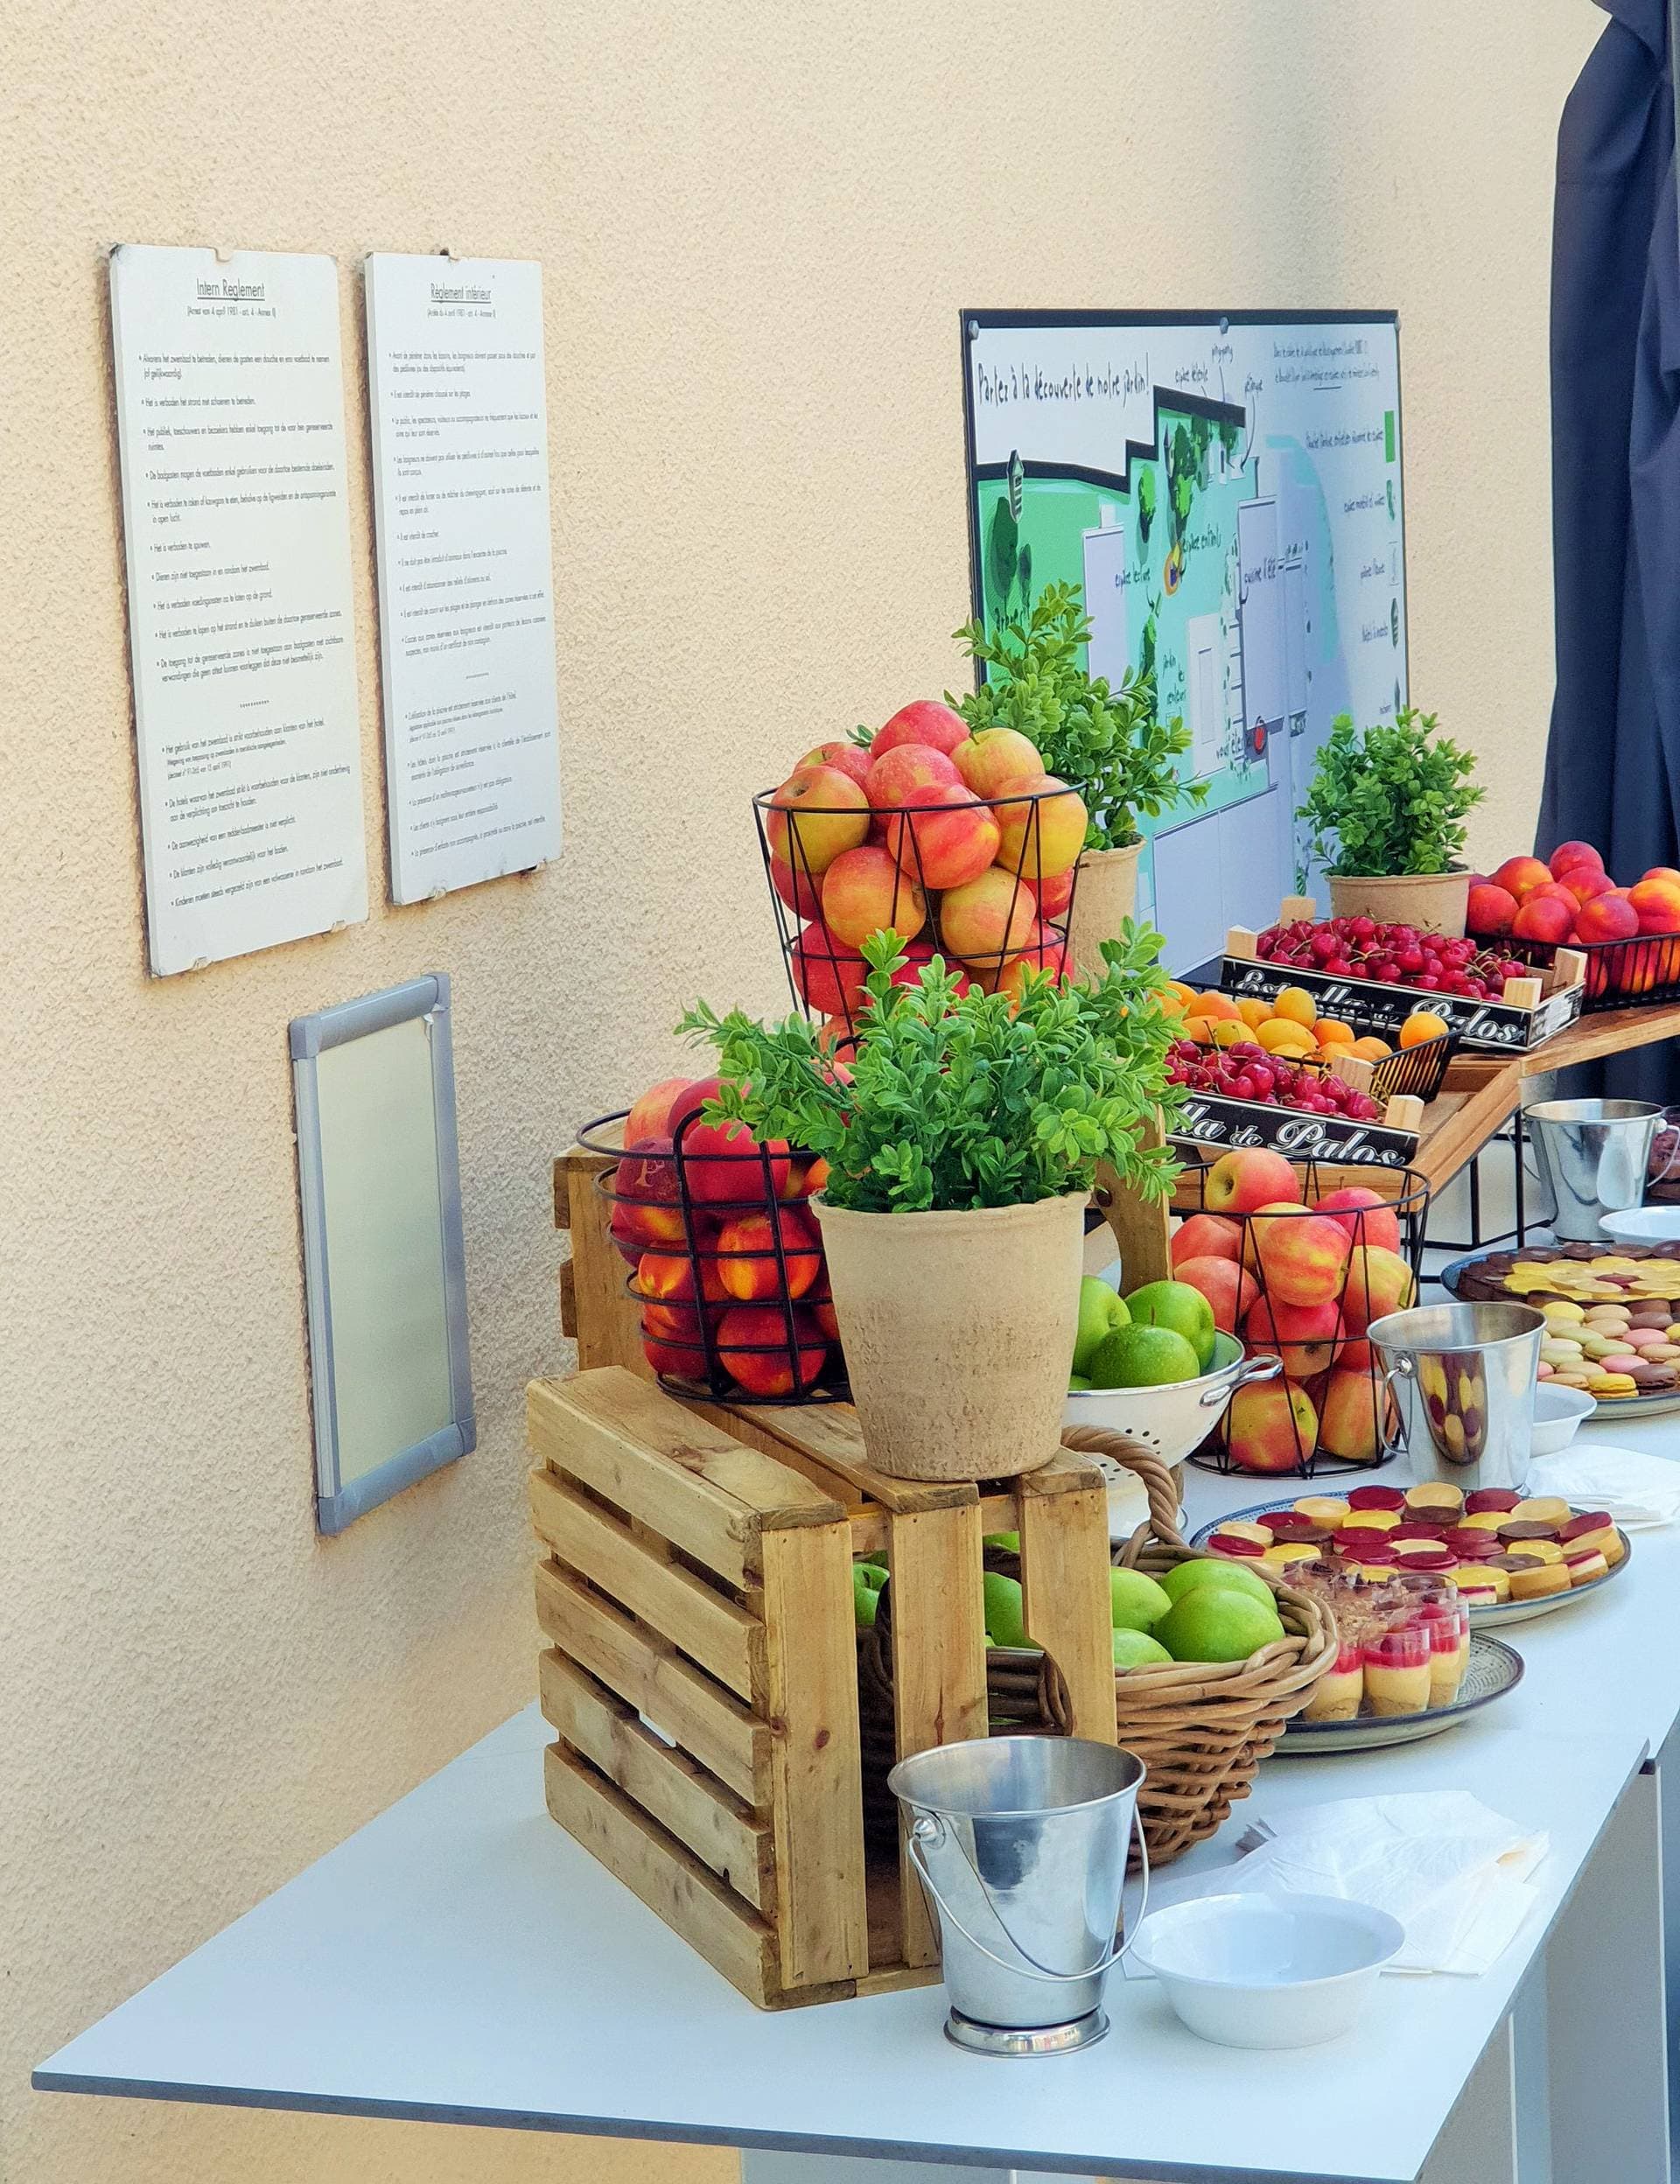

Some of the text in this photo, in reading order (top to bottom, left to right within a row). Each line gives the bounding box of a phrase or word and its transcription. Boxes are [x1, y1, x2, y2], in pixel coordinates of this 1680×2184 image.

[197, 278, 265, 302] Intern Reglement
[978, 361, 1008, 407] Partez
[1022, 362, 1030, 400] la
[1085, 361, 1095, 398] de
[1268, 1118, 1406, 1167] Palos
